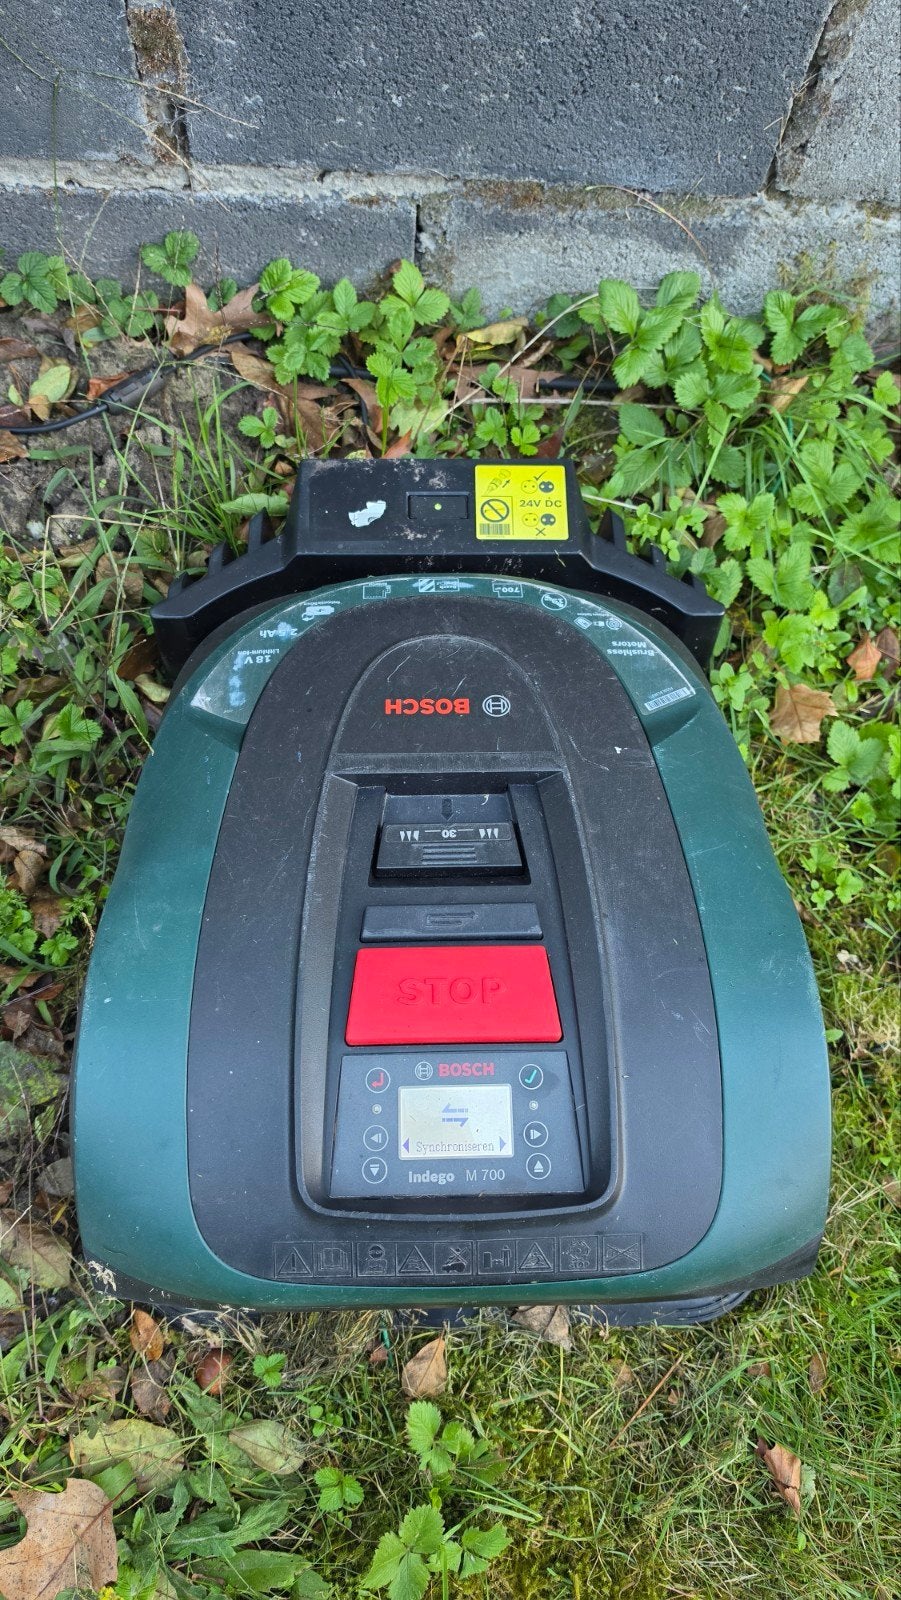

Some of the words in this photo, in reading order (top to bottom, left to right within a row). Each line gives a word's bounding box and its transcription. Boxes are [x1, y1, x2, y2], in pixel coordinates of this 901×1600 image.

[520, 499, 541, 508] 24V
[545, 499, 562, 508] DC
[260, 629, 276, 638] Ah
[611, 640, 647, 648] Motors
[606, 648, 655, 656] Brushless
[244, 656, 254, 665] V
[256, 655, 271, 664] 18
[384, 698, 471, 716] BOSCH
[441, 829, 457, 839] 30
[397, 976, 506, 1006] STOP
[438, 1062, 495, 1077] BOSCH
[416, 1141, 495, 1156] Synchroniseren
[408, 1170, 456, 1186] Indego
[466, 1170, 477, 1182] M
[481, 1169, 506, 1182] 700
